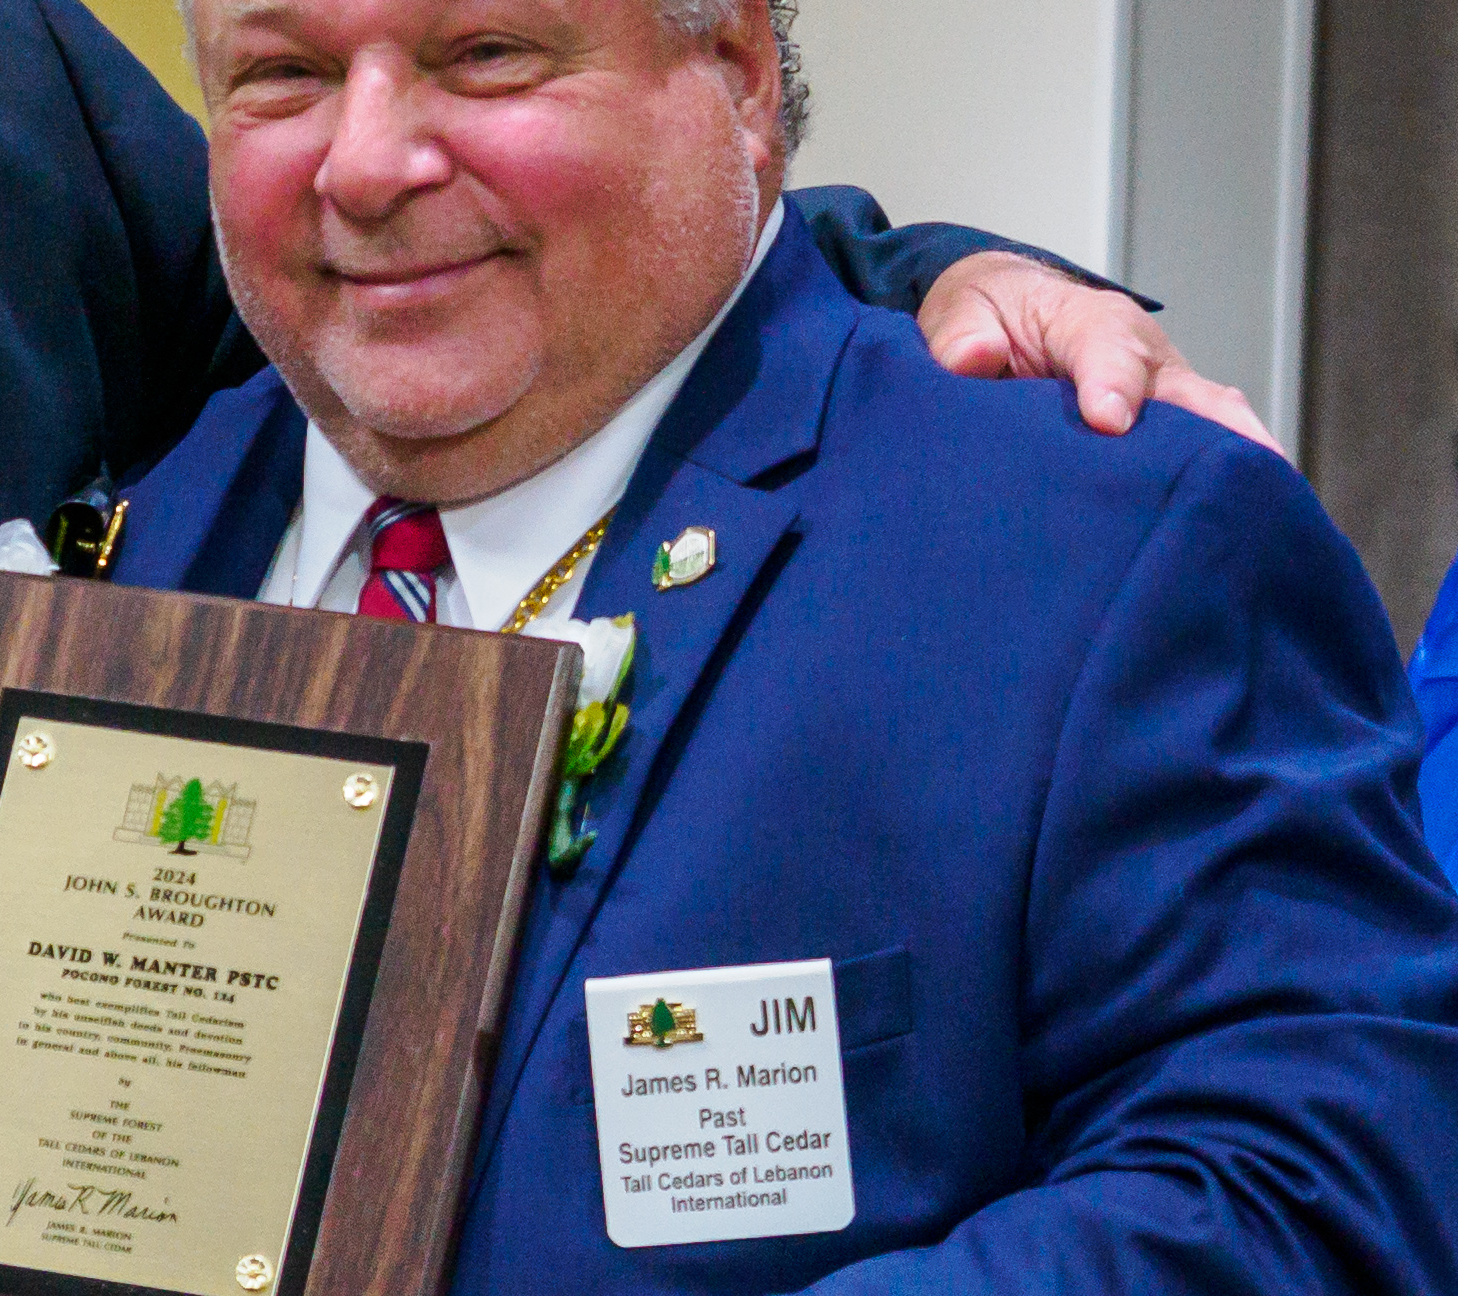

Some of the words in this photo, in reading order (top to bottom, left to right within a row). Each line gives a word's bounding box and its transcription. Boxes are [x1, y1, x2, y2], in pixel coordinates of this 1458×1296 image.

[152, 867, 197, 886] 2024
[63, 874, 118, 895] JOHN
[125, 882, 140, 899] S.
[149, 887, 277, 917] BROUGHTON
[133, 905, 204, 928] AWARD
[27, 941, 93, 964] DAVID
[102, 951, 122, 968] W.
[130, 955, 218, 983] MANTER
[227, 969, 281, 991] PSTC
[61, 967, 120, 985] POCONO
[124, 976, 179, 995] FOREST
[40, 991, 62, 1003] who
[750, 995, 817, 1037] JIM
[168, 1027, 189, 1038] and
[32, 1040, 74, 1053] general
[621, 1073, 697, 1097] James
[705, 1068, 729, 1091] R.
[736, 1062, 818, 1088] Marion
[110, 1100, 131, 1111] THE
[70, 1110, 119, 1126] SUPREME
[123, 1118, 163, 1132] FOREST
[699, 1107, 747, 1129] Past
[92, 1130, 107, 1140] OF
[112, 1133, 133, 1144] THE
[619, 1138, 715, 1167] Supreme
[722, 1133, 759, 1156] Tall
[765, 1130, 832, 1153] Cedar
[38, 1138, 61, 1150] TALL
[65, 1142, 106, 1156] CEDARS
[129, 1153, 179, 1168] LEBANON
[62, 1158, 146, 1180] INTERNATIONAL
[620, 1174, 652, 1194] Tall
[658, 1169, 724, 1191] Cedars
[729, 1167, 748, 1184] of
[753, 1162, 833, 1184] Lebanon
[671, 1188, 788, 1214] International
